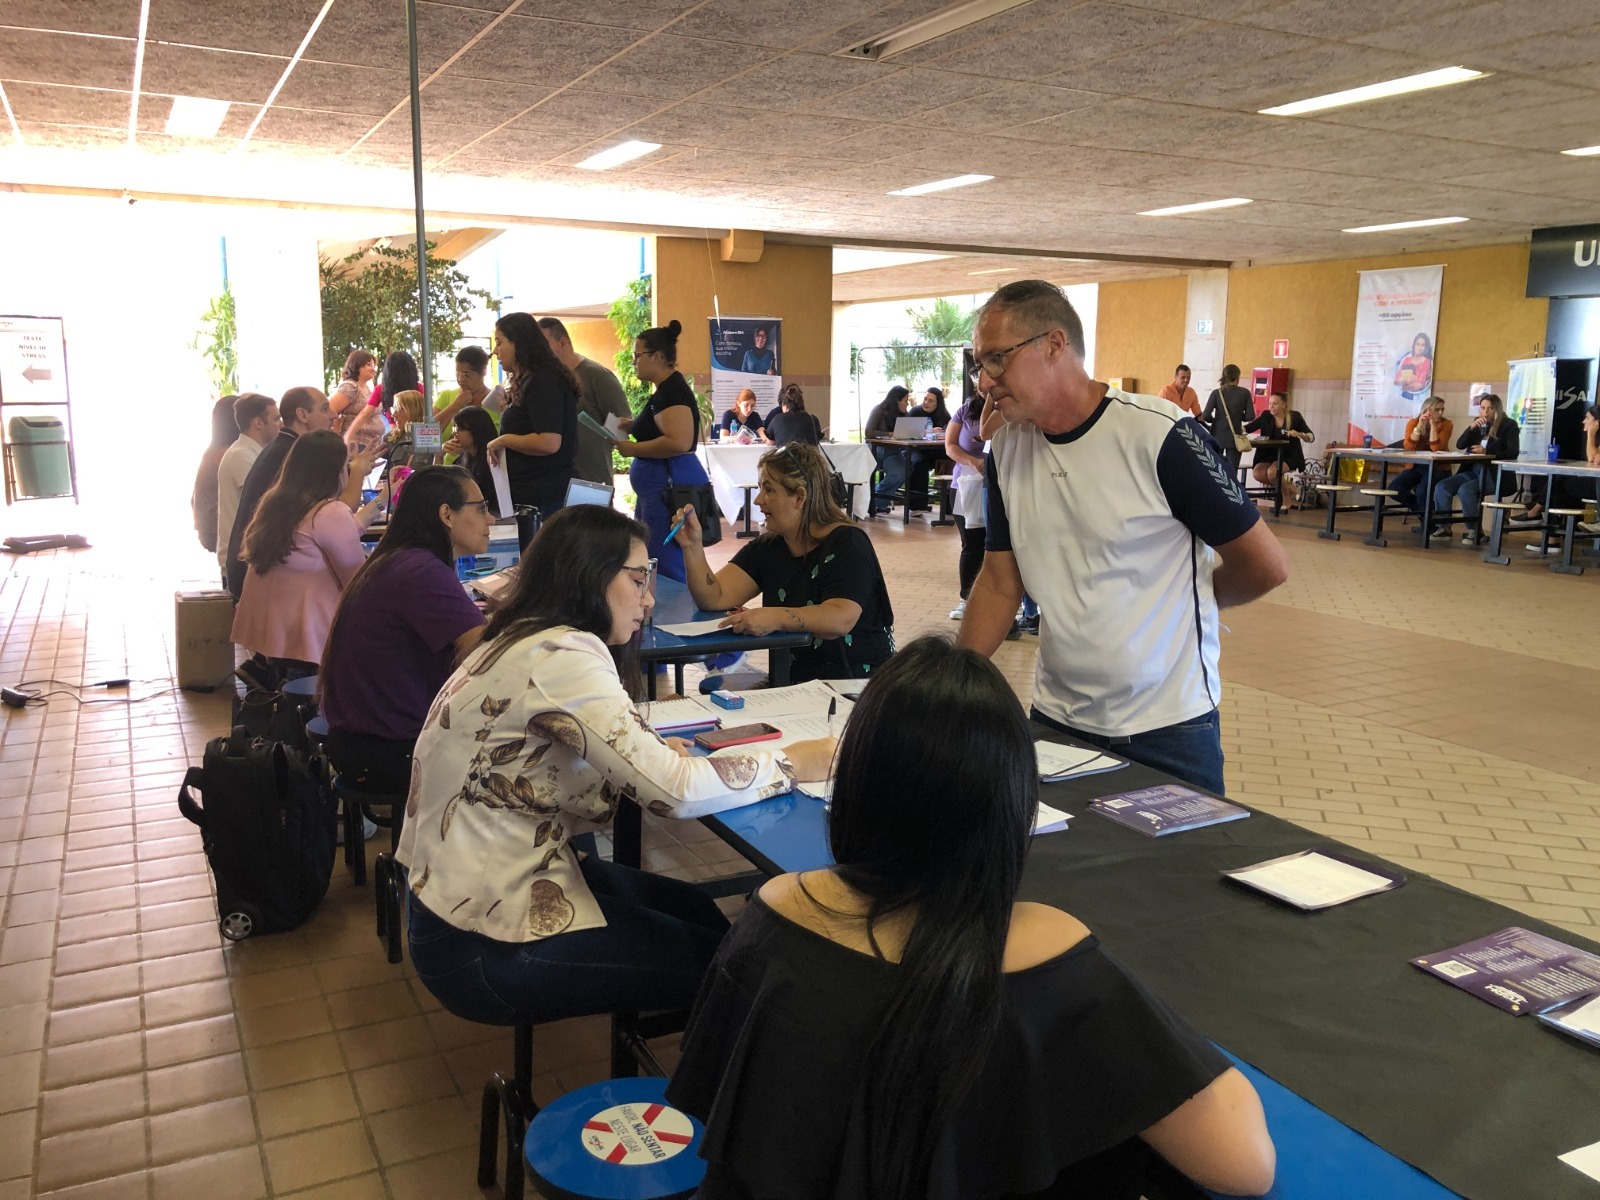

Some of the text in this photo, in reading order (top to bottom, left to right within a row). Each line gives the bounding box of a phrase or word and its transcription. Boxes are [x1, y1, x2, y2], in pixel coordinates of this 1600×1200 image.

[1573, 239, 1600, 268] U
[632, 1121, 649, 1136] NÃO
[641, 1134, 667, 1160] SENTAR
